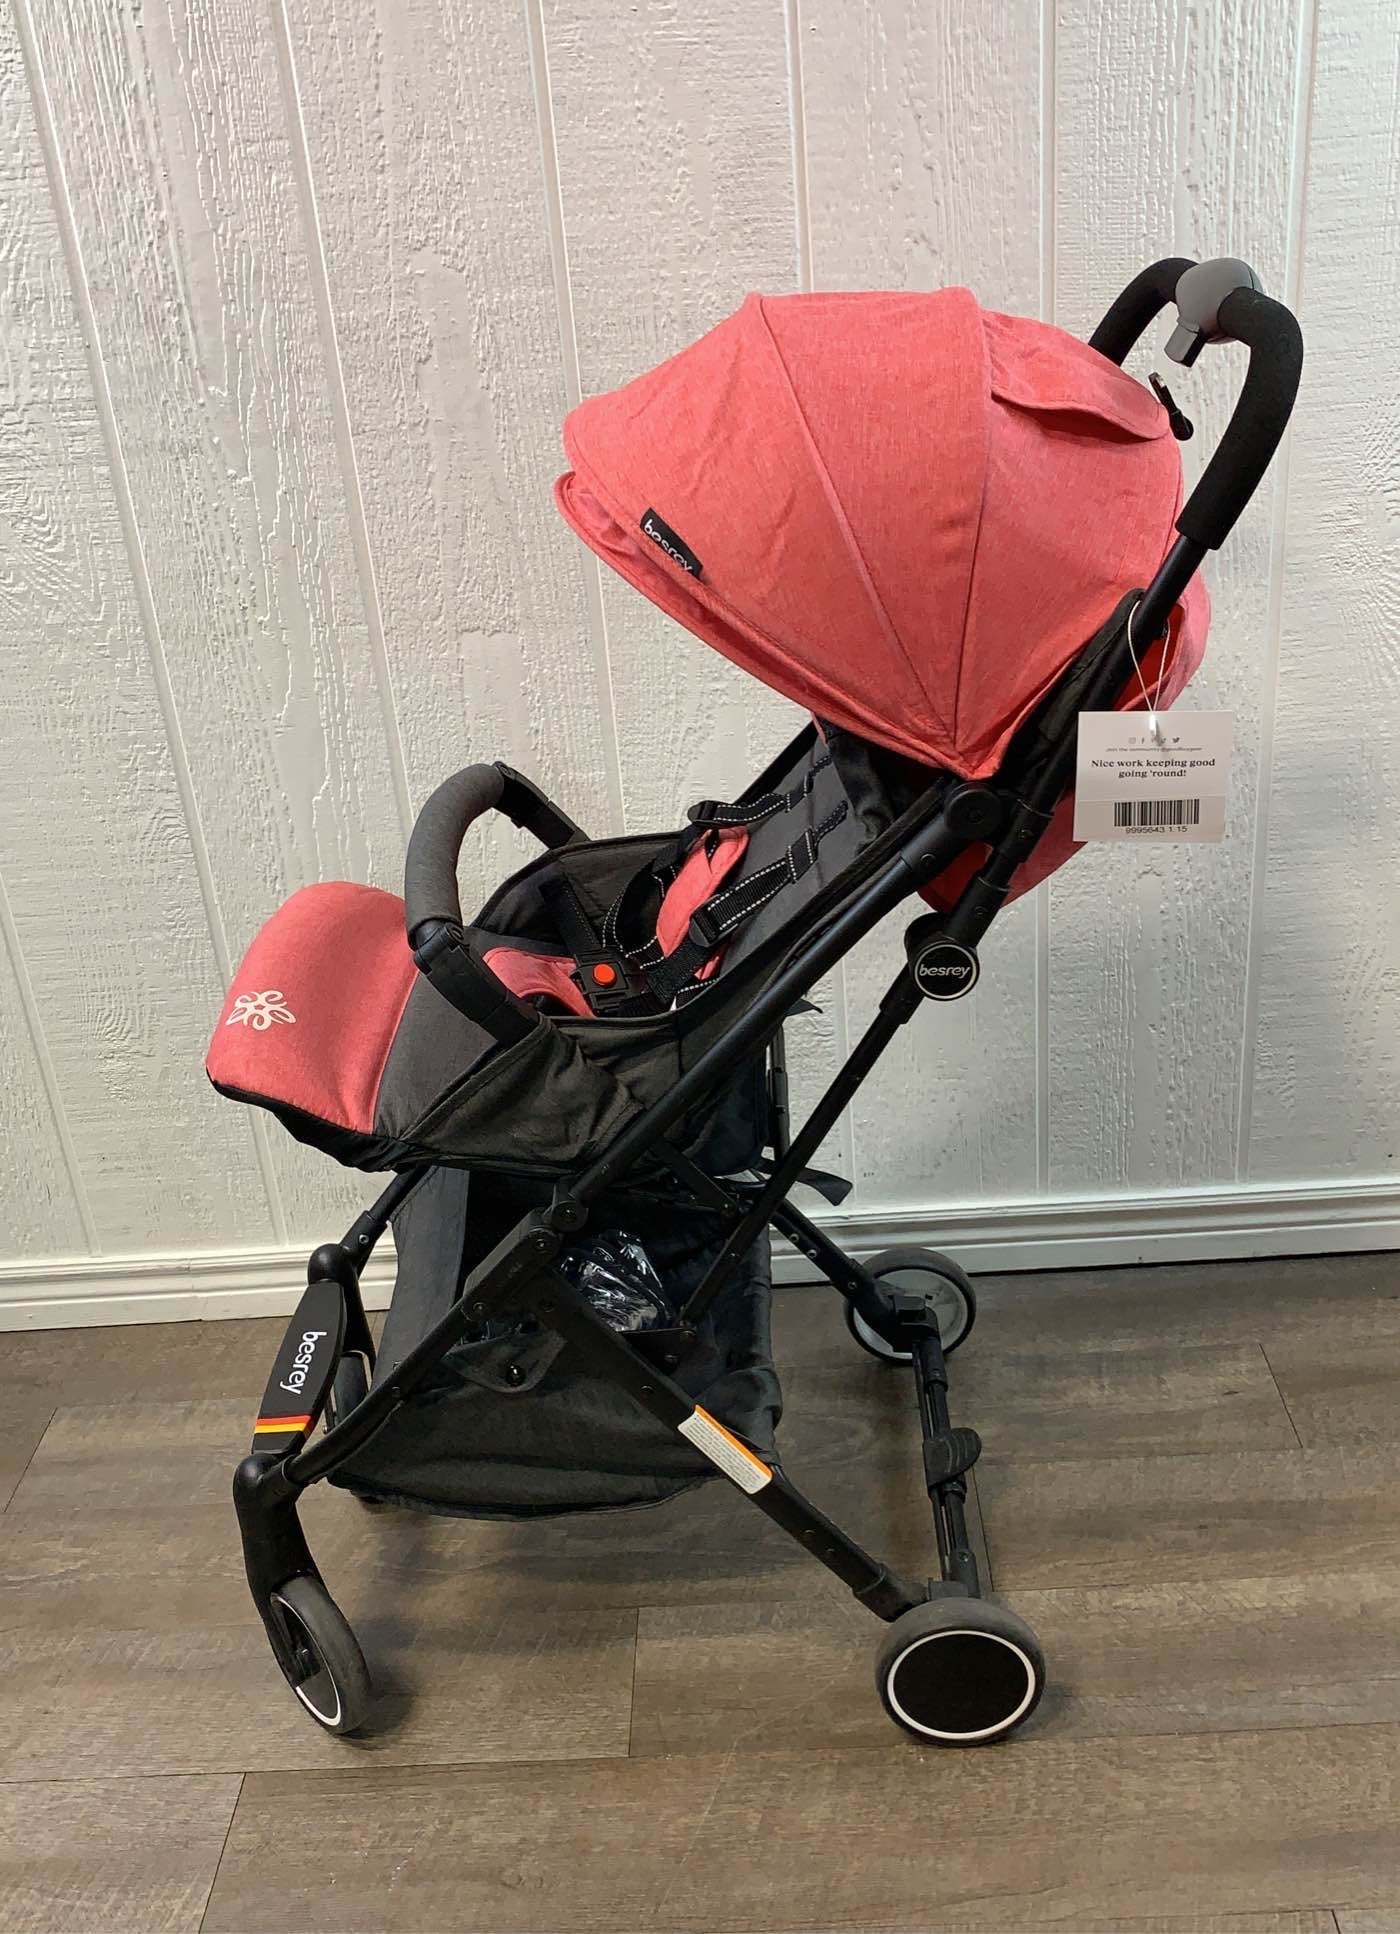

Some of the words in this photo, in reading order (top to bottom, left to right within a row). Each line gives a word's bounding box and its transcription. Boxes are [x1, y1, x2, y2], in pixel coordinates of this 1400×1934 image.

[1091, 759, 1115, 768] Nice
[1117, 759, 1144, 768] work
[1146, 759, 1188, 769] keeping
[1189, 758, 1216, 768] good
[1118, 769, 1148, 779] going
[1149, 769, 1187, 778] 'round!
[919, 963, 971, 979] besrey
[279, 1331, 328, 1395] besrey
